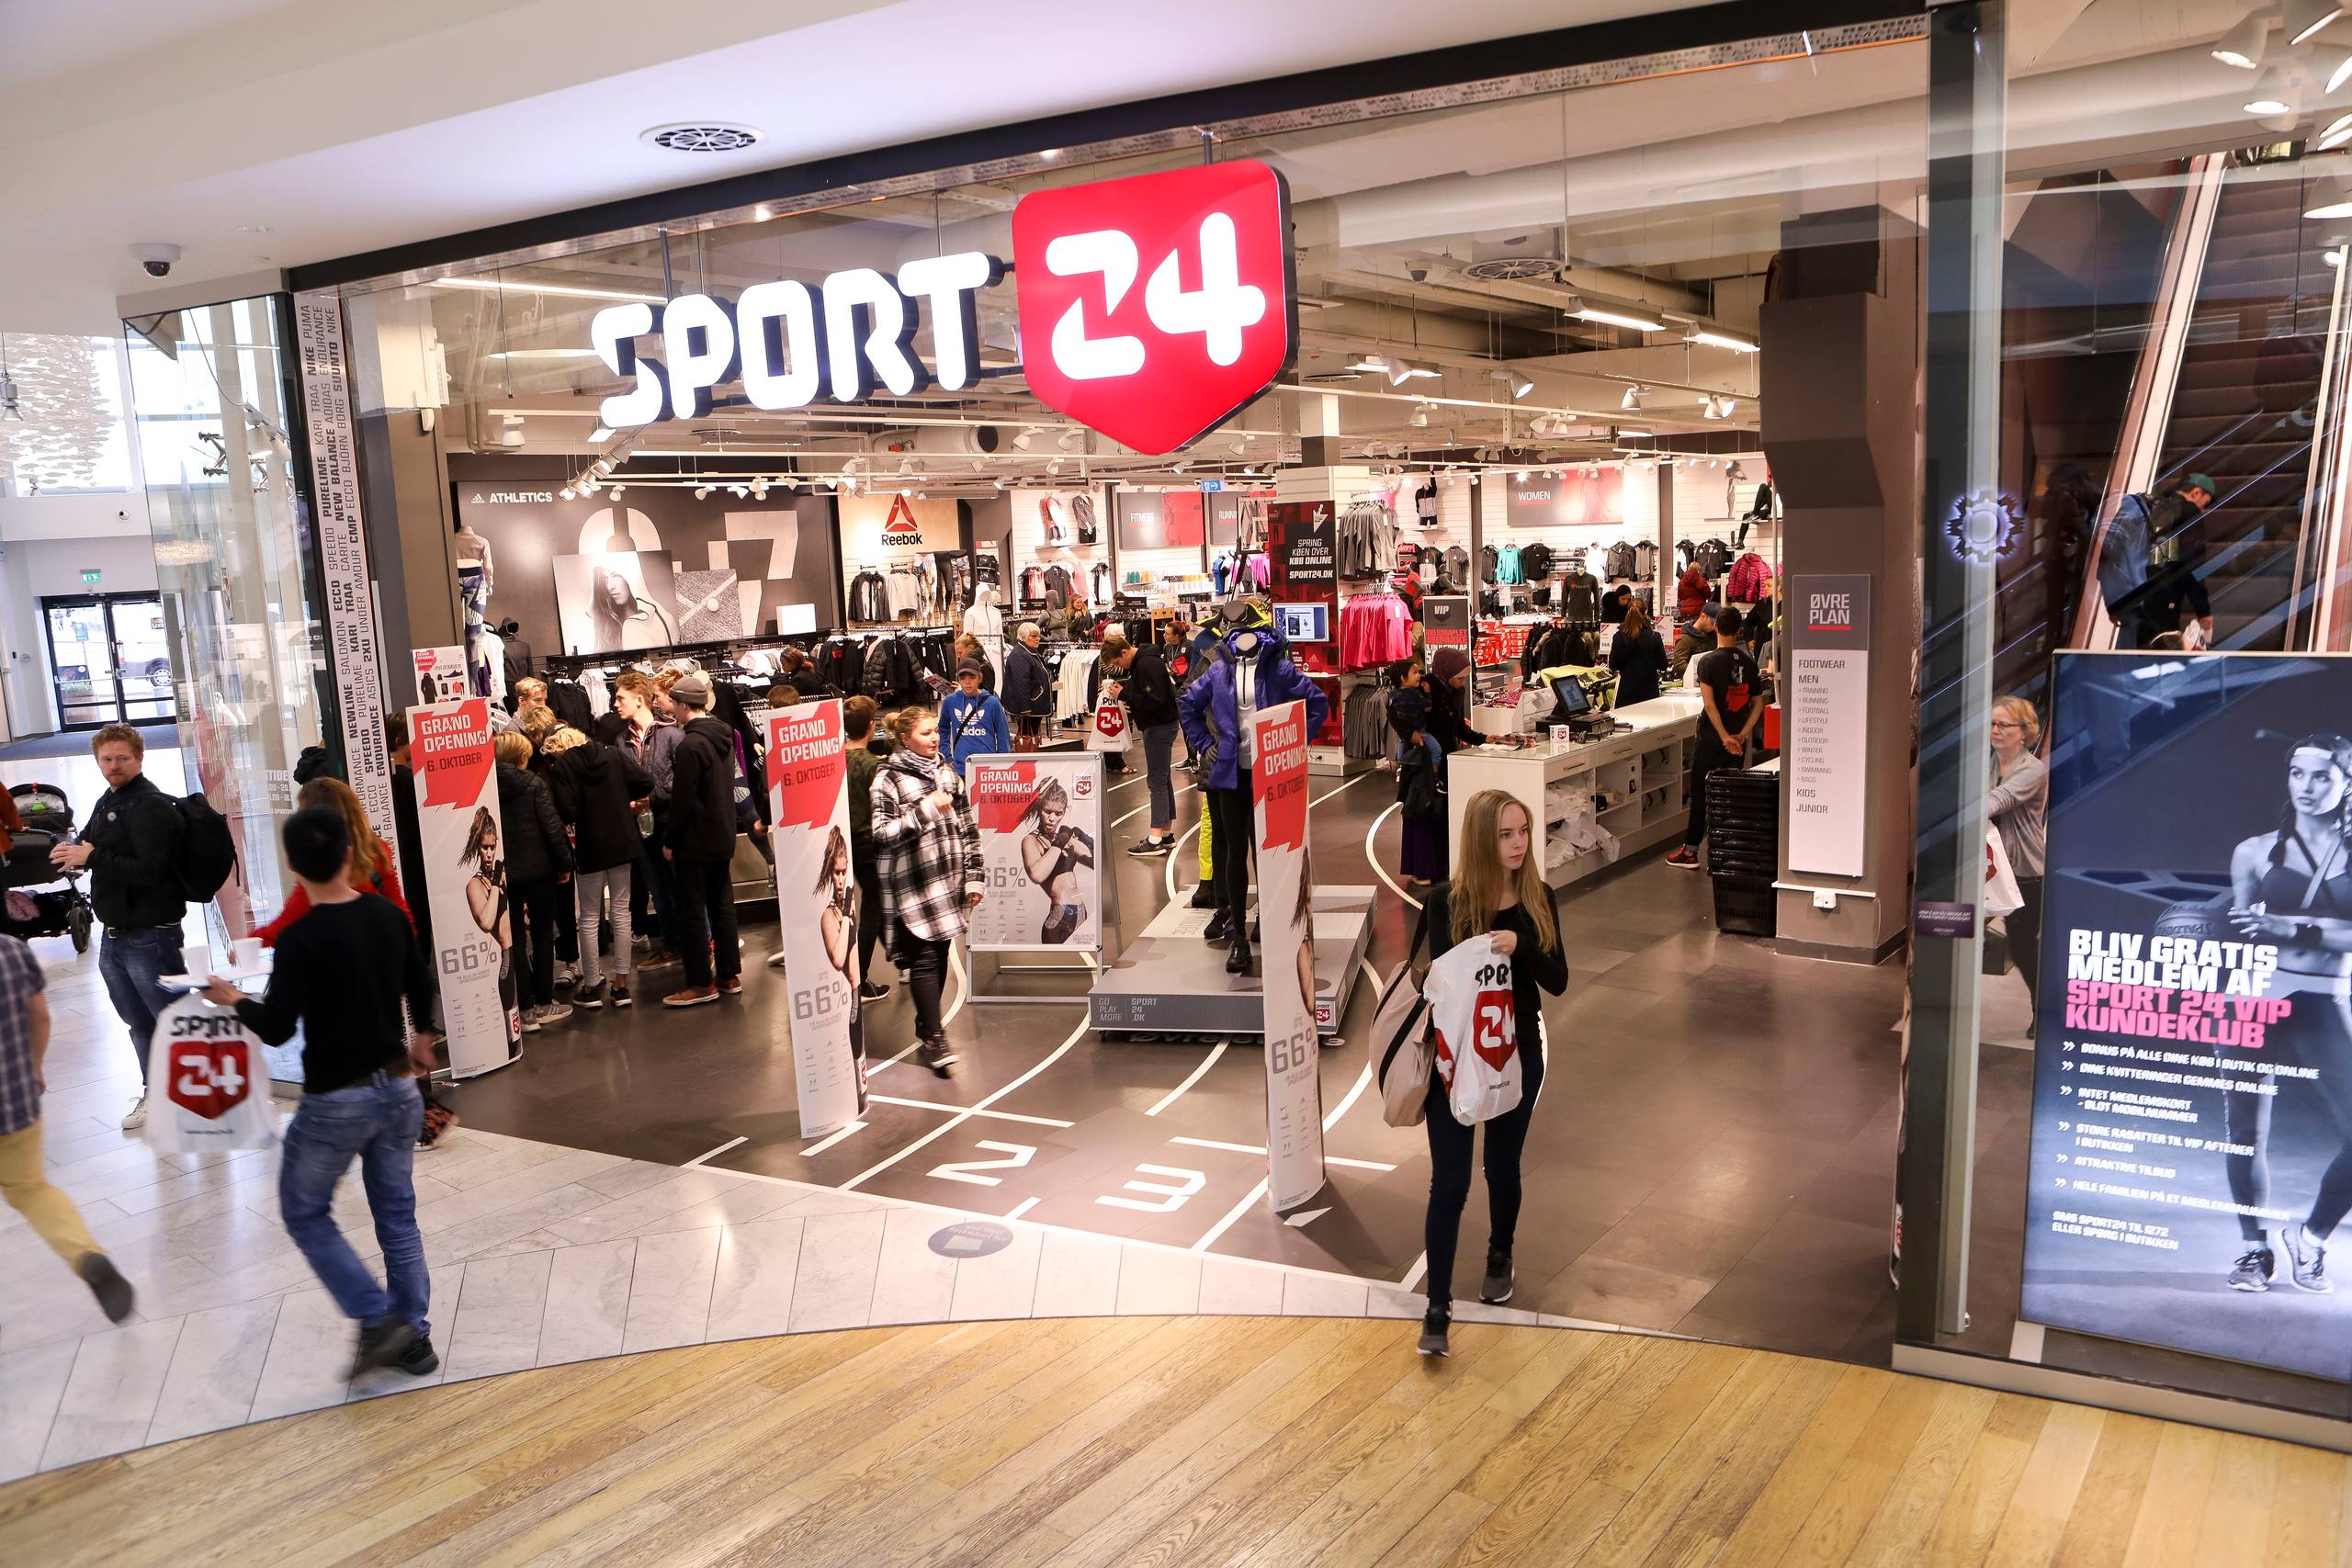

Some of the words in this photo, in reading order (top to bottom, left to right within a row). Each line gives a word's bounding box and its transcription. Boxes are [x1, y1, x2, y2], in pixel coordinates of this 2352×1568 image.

[1045, 212, 1266, 380] 24
[300, 305, 311, 339] PUMA
[325, 308, 337, 333] NIKE
[312, 306, 329, 376] ENDURANCE
[591, 252, 989, 428] SPORT
[305, 345, 317, 376] NIKE
[329, 342, 342, 392] SUUNTO
[309, 384, 321, 412] TRAA
[322, 383, 334, 423] ADIDAS
[334, 399, 346, 429] BORG
[312, 420, 323, 446] KARI
[326, 428, 341, 485] BALANCE
[317, 456, 333, 517] PURELIME
[344, 479, 356, 509] ECCO
[490, 492, 553, 503] ATHLETICS
[1518, 491, 1551, 501] WOMEN
[333, 492, 345, 522] NEW
[347, 514, 359, 544] CMP
[882, 533, 923, 546] Reebok
[1297, 538, 1322, 547] SPRING
[325, 527, 338, 570] SPEEDO
[337, 534, 350, 571] CARITE
[1292, 548, 1310, 557] KØEN
[1312, 547, 1329, 556] OVER
[1305, 557, 1332, 565] ONLINE
[351, 549, 364, 590] AMOUR
[1289, 570, 1333, 579] SPORT24.DK
[331, 580, 344, 612] ECCO
[344, 582, 356, 615] TRAA
[1434, 606, 1450, 615] VIP
[1810, 593, 1850, 609] ØVRE
[356, 595, 369, 633] UNDER
[1809, 609, 1850, 625] PLAN
[335, 620, 351, 675] SALOMON
[348, 624, 360, 653] KARI
[361, 638, 372, 662] 2XU
[1798, 675, 1819, 683] MEN
[1799, 660, 1846, 669] FOOTWEAR
[353, 664, 368, 718] PURELIME
[365, 668, 378, 700] ASICS
[344, 683, 358, 739] NEWLINE
[421, 714, 471, 735] GRAND
[1101, 713, 1122, 728] 24
[369, 705, 386, 777] ENDURANCE
[424, 729, 486, 753] OPENING
[778, 719, 826, 744] GRAND
[1263, 724, 1298, 751] GRAND
[360, 728, 374, 773] SPEEDO
[426, 760, 438, 772] 6.
[439, 751, 482, 770] OKTOBER
[781, 737, 840, 764] OPENING
[784, 773, 795, 786] 6.
[797, 762, 836, 784] OKTOBER
[979, 772, 1019, 781] GRAND
[980, 783, 1032, 794] OPENING
[1078, 782, 1091, 790] 24
[368, 784, 379, 814] ECCO
[379, 782, 392, 831] BALANCE
[990, 795, 1031, 804] OKTOBER
[1796, 788, 1816, 797] KIDS
[1796, 803, 1828, 814] JUNIOR
[441, 938, 498, 975] 66%
[2069, 929, 2143, 960] BLIV
[2151, 935, 2278, 972] GRATIS
[2067, 953, 2219, 993] MEDLEM
[2224, 968, 2273, 998] AF
[794, 976, 848, 1021] 66%
[1099, 998, 1110, 1006] GO
[1131, 998, 1158, 1006] SPORT
[2067, 979, 2175, 1013] SPORT
[2179, 989, 2227, 1020] 24
[2233, 996, 2292, 1025] VIP
[1316, 1010, 1329, 1020] 24
[2065, 1003, 2266, 1049] KUNDEKLUB
[1272, 1027, 1316, 1074] 66%
[2080, 1043, 2119, 1056] BONUS
[2120, 1046, 2135, 1058] PÅ
[2136, 1049, 2163, 1062] ALLE
[2163, 1052, 2190, 1064] DINE
[2190, 1055, 2215, 1067] KØB
[2216, 1058, 2222, 1067] I
[2222, 1059, 2256, 1073] BUTIK
[2256, 1064, 2275, 1075] OG
[2275, 1066, 2320, 1080] ONLINE
[177, 1055, 245, 1096] 24
[2080, 1063, 2106, 1075] DINE
[2106, 1066, 2183, 1084] KVITTERINGER
[2183, 1075, 2234, 1091] GEMMES
[2234, 1081, 2278, 1096] ONLINE
[2078, 1088, 2109, 1100] INTET
[2109, 1091, 2193, 1110] MEDLEMSKORT
[2084, 1100, 2111, 1111] BLOT
[2111, 1103, 2198, 1123] MOBILNUMMER
[2075, 1136, 2080, 1146] I
[2081, 1137, 2133, 1154] BUTIKKEN
[2076, 1123, 2111, 1135] STORE
[2111, 1128, 2166, 1145] RABATTER
[2167, 1135, 2183, 1146] TIL
[2185, 1137, 2204, 1148] VIP
[2203, 1141, 2255, 1156] AFTENER
[926, 1140, 1037, 1187] 2
[2074, 1156, 2138, 1174] ATTRAKTIVE
[2138, 1165, 2176, 1179] TILBUD
[2073, 1179, 2098, 1192] HELE
[2098, 1183, 2150, 1200] FAMILIEN
[2150, 1190, 2165, 1201] PÅ
[2166, 1194, 2181, 1204] ET
[2181, 1196, 2290, 1222] MEDLEMSNUMMER
[2052, 1211, 2078, 1224] SMS
[2078, 1214, 2128, 1231] SPORT24
[2128, 1222, 2144, 1233] TIL
[2052, 1222, 2083, 1235] ELLER
[2083, 1226, 2119, 1240] SPØRG
[2120, 1232, 2124, 1242] I
[2124, 1233, 2179, 1250] BUTIKKEN
